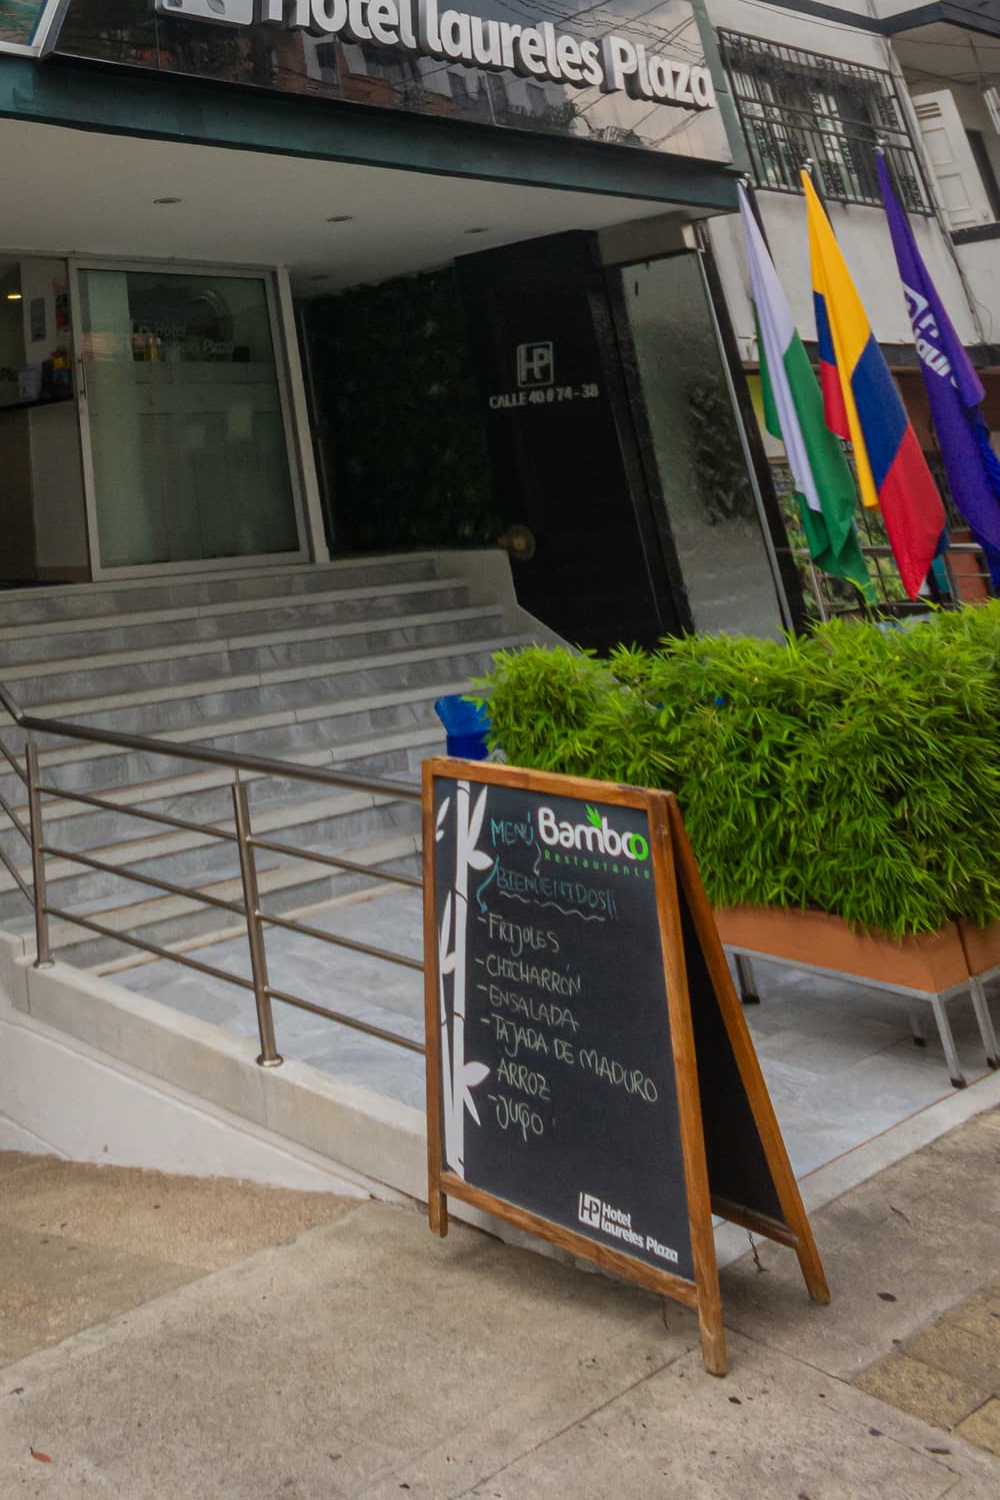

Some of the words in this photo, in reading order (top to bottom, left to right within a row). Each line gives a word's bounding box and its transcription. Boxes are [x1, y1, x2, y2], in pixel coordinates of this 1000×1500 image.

[602, 34, 716, 109] Plaza
[488, 391, 528, 409] CALLE
[528, 389, 545, 404] 40
[556, 385, 573, 402] 74
[537, 806, 649, 861] Bamboo
[544, 849, 650, 880] Restaurante
[497, 1057, 551, 1101] ARROZ
[554, 1038, 575, 1065] DE
[580, 1048, 658, 1103] MADURO
[602, 1202, 632, 1229] Hotel
[601, 1217, 645, 1249] laureles
[646, 1236, 679, 1264] Plaza
